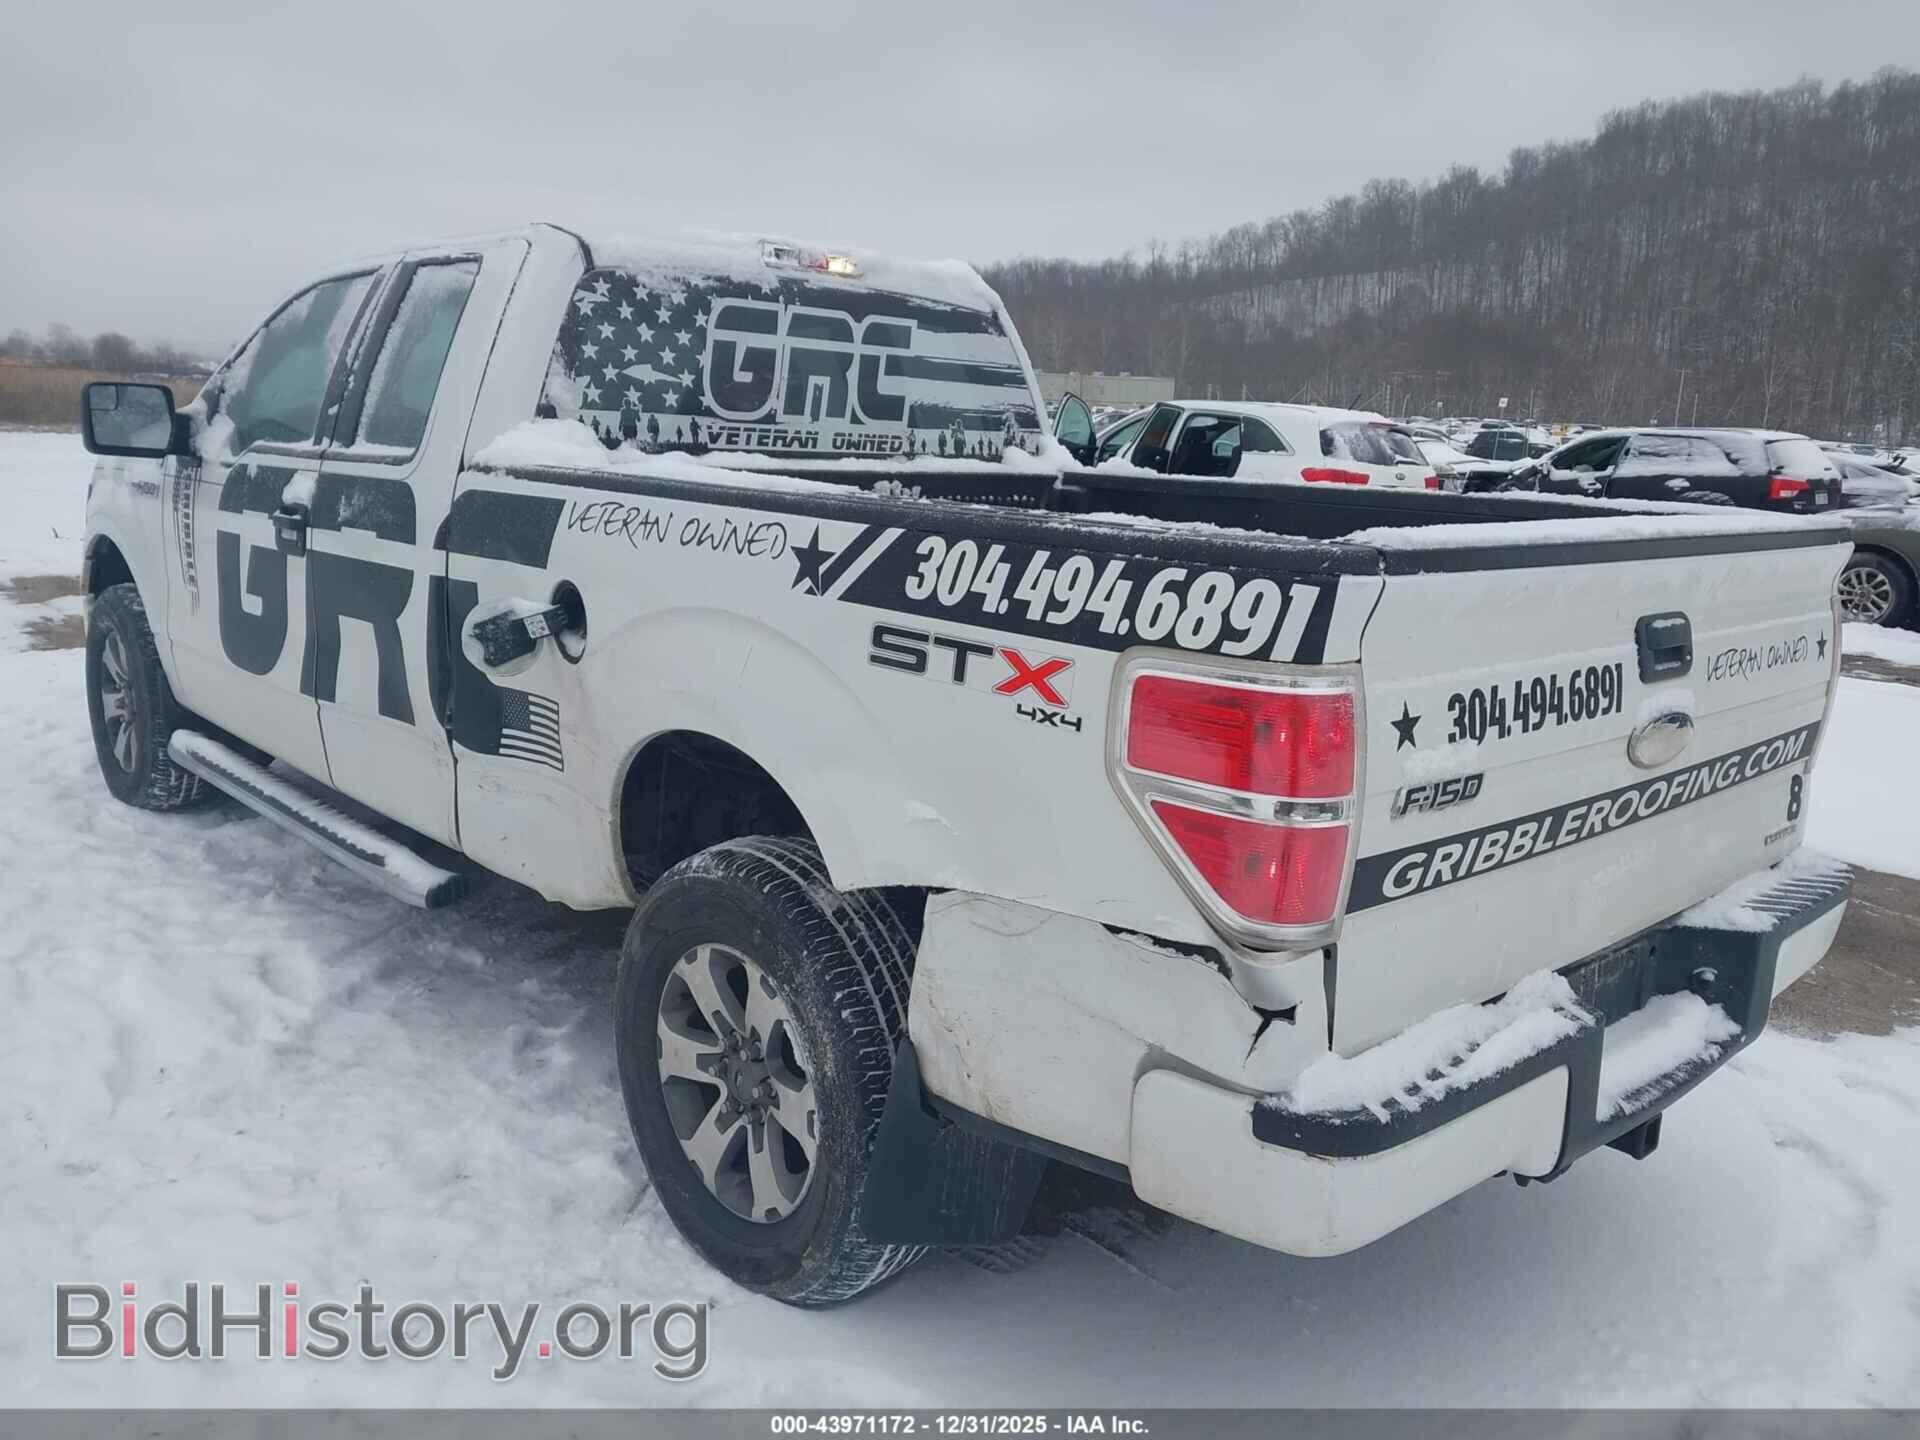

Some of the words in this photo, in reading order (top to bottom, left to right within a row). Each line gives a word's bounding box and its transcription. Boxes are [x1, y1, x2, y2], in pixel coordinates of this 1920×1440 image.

[705, 298, 917, 425] GRC
[706, 425, 819, 449] VETERAN
[832, 432, 903, 452] OWNED
[565, 500, 674, 547] VETERAN
[679, 519, 788, 559] OWNED
[216, 464, 566, 756] GRC
[904, 535, 1321, 661] 304.494.6891
[867, 624, 1075, 708] STX
[1706, 648, 1762, 681] VETERAN
[1767, 635, 1808, 668] OWNED
[1447, 663, 1623, 746] 304.494.6891
[1381, 729, 1808, 899] GRIBBLEROOFING.COM
[1393, 772, 1485, 819] F-150
